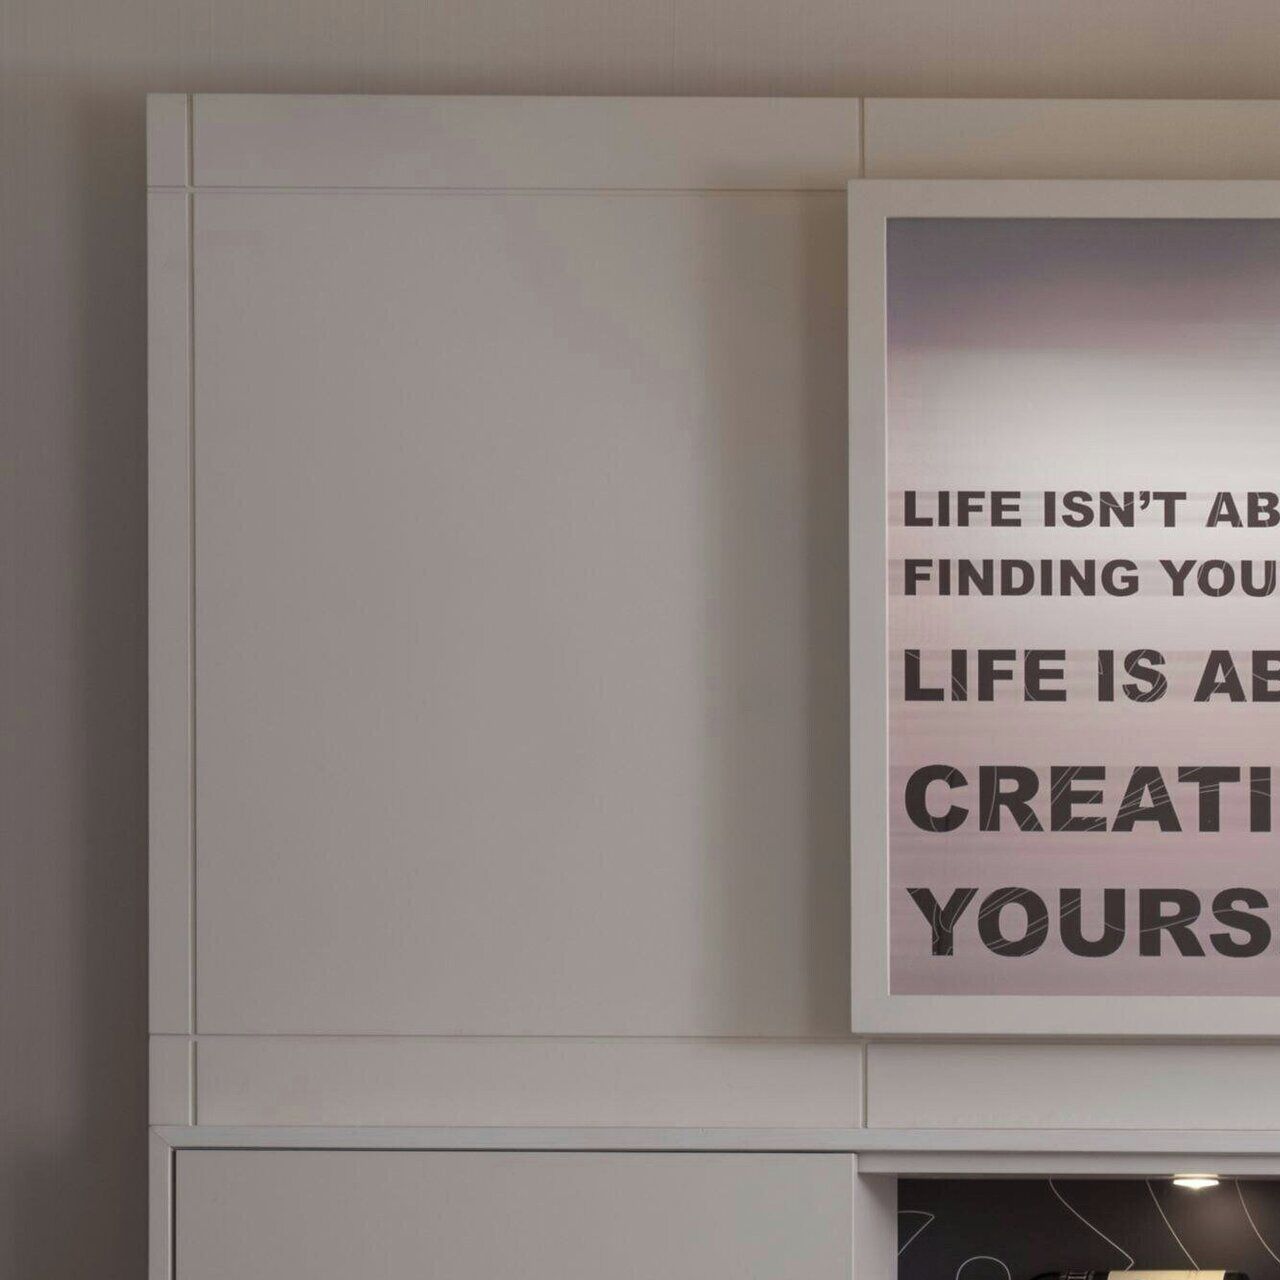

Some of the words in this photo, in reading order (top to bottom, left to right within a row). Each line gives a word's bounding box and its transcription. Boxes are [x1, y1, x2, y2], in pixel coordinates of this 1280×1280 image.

[904, 491, 1022, 529] LIFE
[1044, 490, 1187, 529] ISN’T
[904, 559, 1140, 598] FINDING
[904, 650, 1067, 703] LIFE
[1098, 650, 1168, 704] IS
